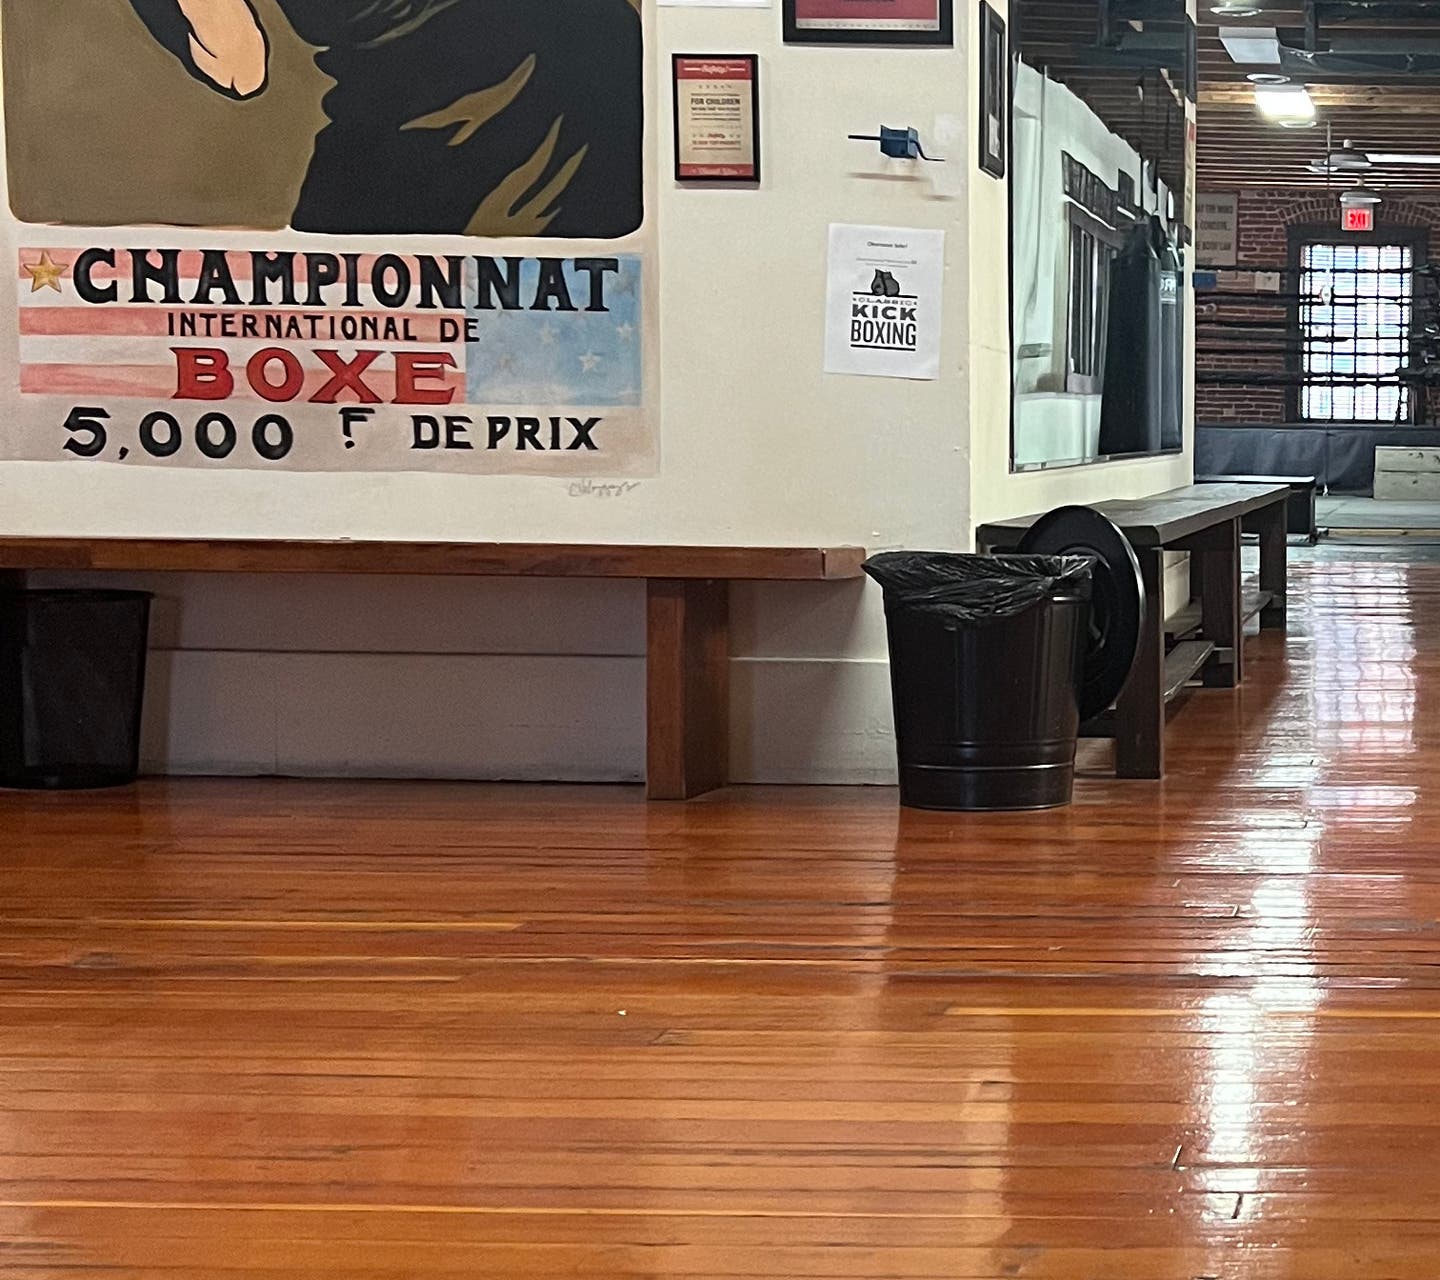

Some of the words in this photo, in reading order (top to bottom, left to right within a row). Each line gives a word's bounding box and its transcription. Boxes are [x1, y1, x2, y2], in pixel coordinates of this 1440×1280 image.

[72, 247, 619, 312] CHAMPIONNAT
[167, 312, 418, 342] INTERNATIONAL
[439, 317, 480, 343] DE
[851, 320, 916, 346] BOXING
[852, 304, 917, 321] KICK
[170, 346, 458, 405] BOXE
[62, 406, 294, 461] 5,000
[411, 416, 469, 450] DE
[486, 416, 603, 451] PRIX
